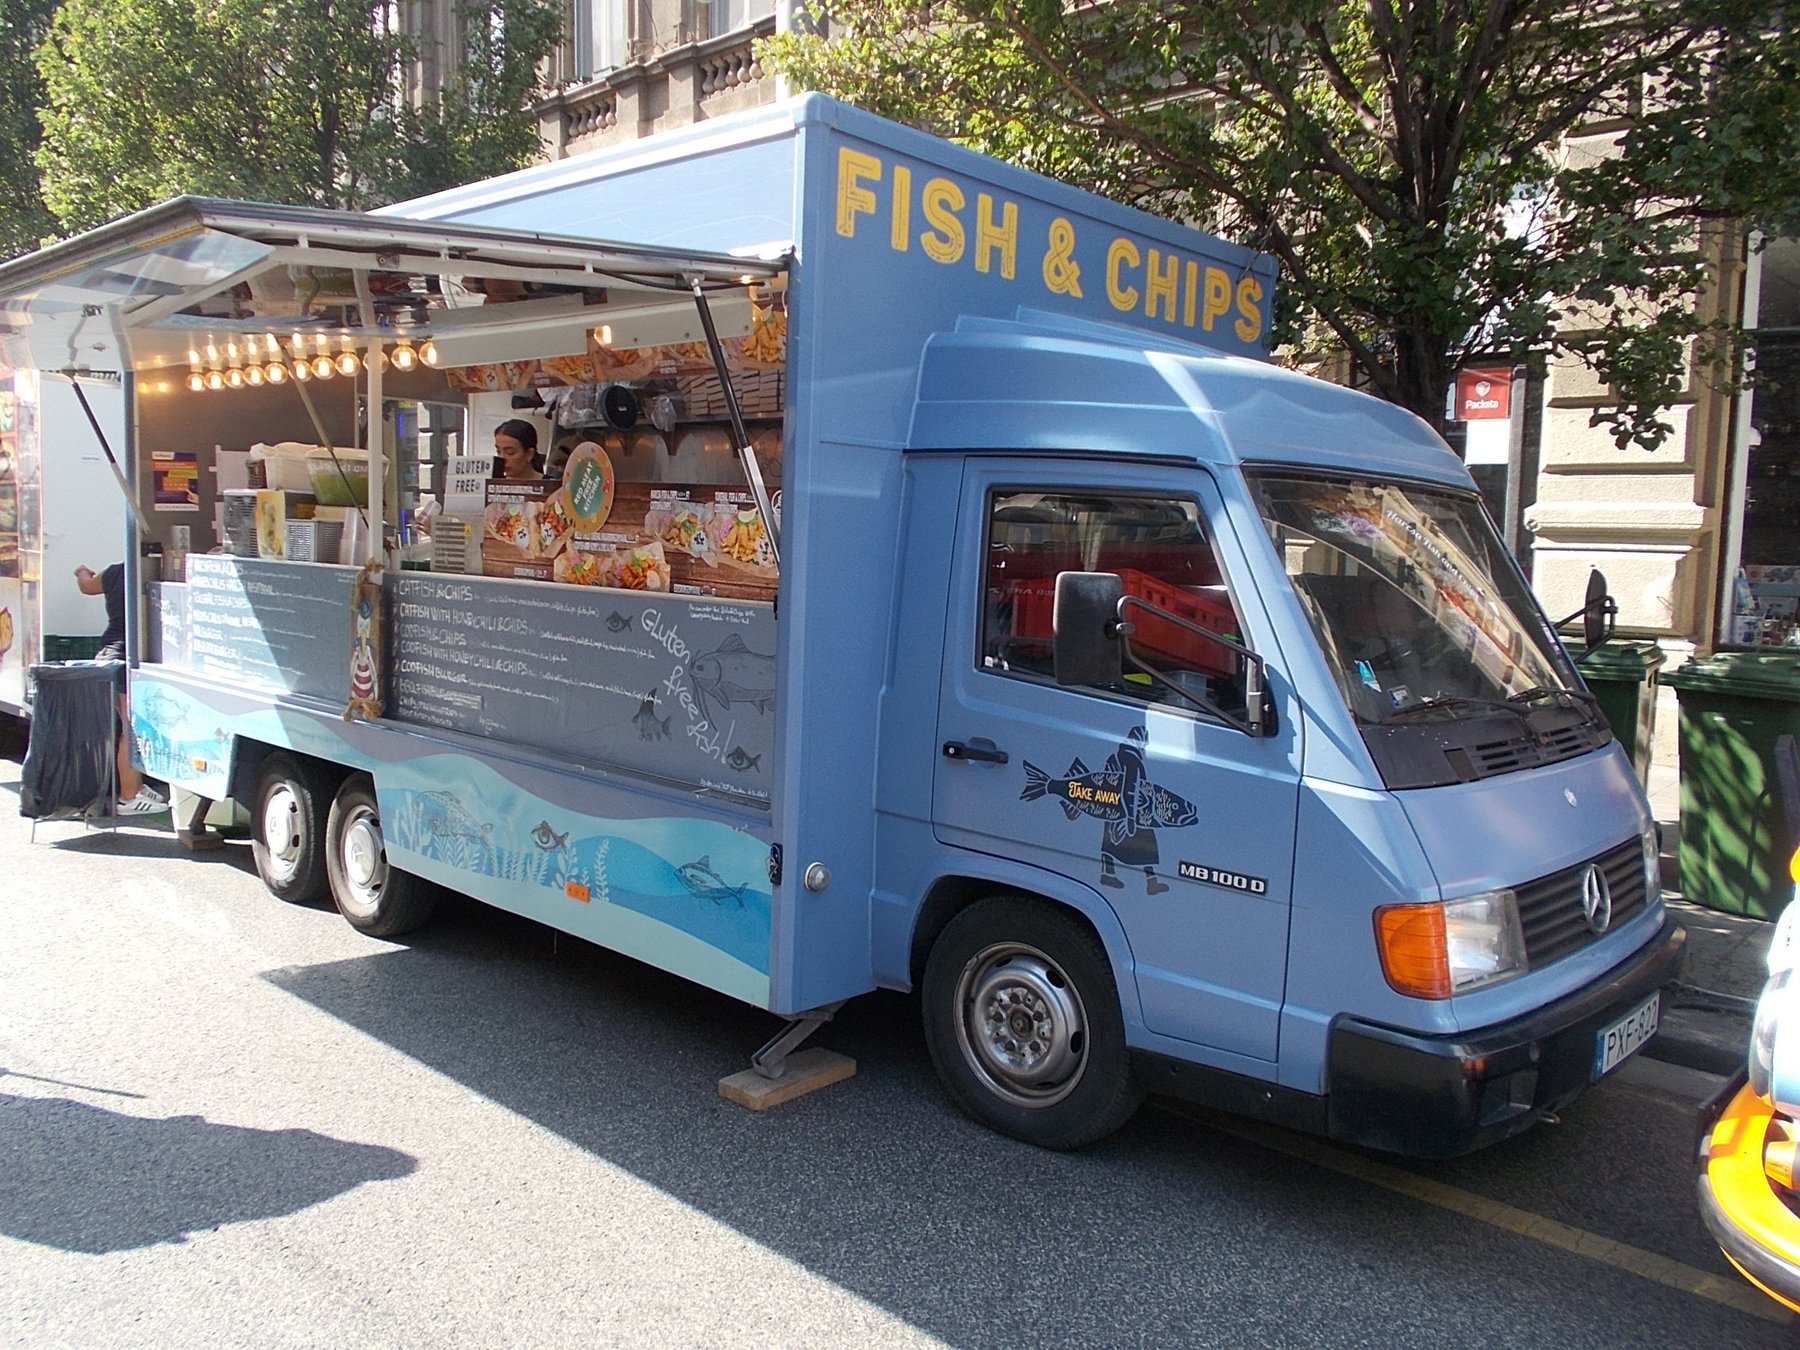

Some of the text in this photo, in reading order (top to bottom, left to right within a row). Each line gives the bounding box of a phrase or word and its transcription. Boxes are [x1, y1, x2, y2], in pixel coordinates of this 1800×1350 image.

[835, 146, 1264, 342] FISH & CHIPS
[455, 460, 485, 475] GLUTEN
[455, 480, 476, 493] FREE
[583, 475, 601, 512] KITCHEN
[399, 580, 435, 598] CATFISH
[400, 602, 431, 620] CATFISH
[430, 606, 452, 624] WITH
[663, 665, 698, 720] free
[1069, 781, 1120, 805] TAKE AWAY
[1180, 864, 1265, 893] MB 100 D
